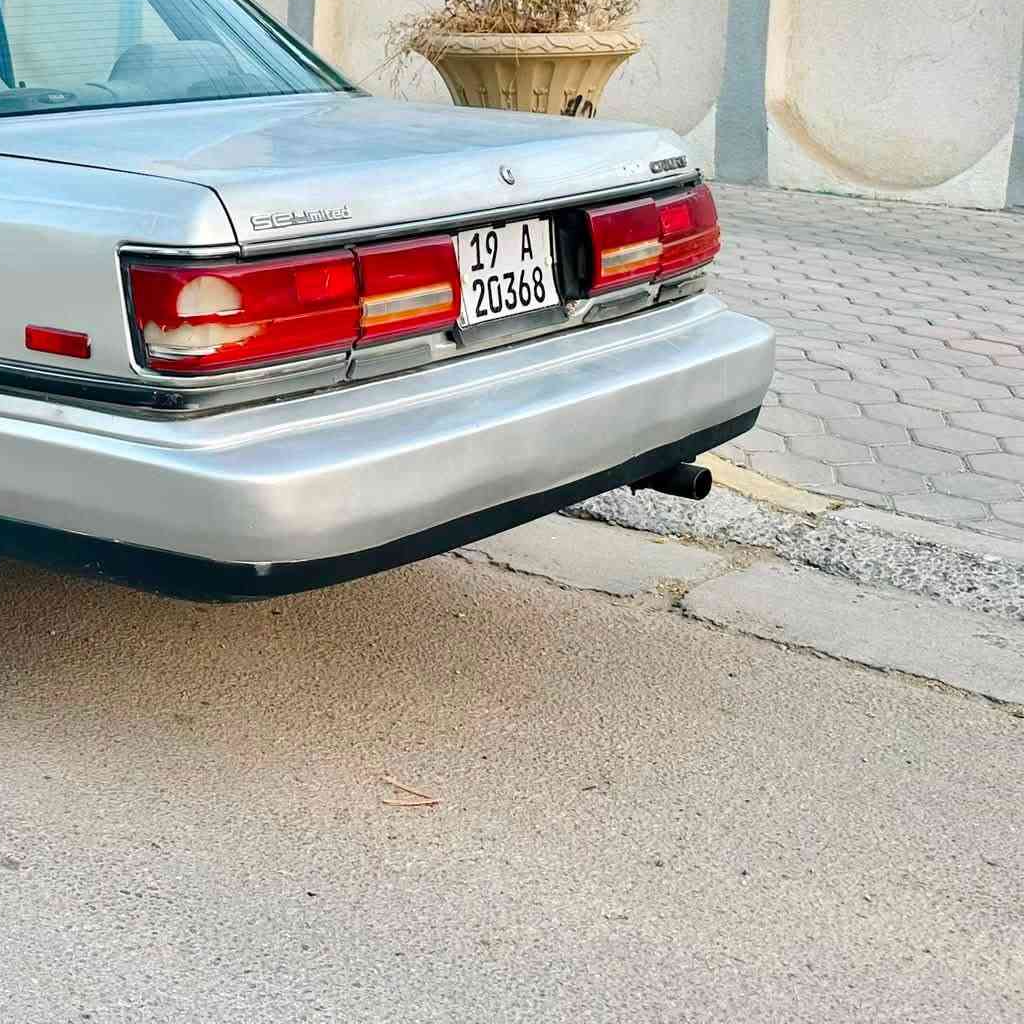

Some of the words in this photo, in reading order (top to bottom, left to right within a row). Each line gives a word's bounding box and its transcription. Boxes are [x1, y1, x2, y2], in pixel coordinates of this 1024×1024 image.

[470, 230, 498, 272] 19
[521, 224, 533, 262] A
[472, 265, 546, 318] 20368
